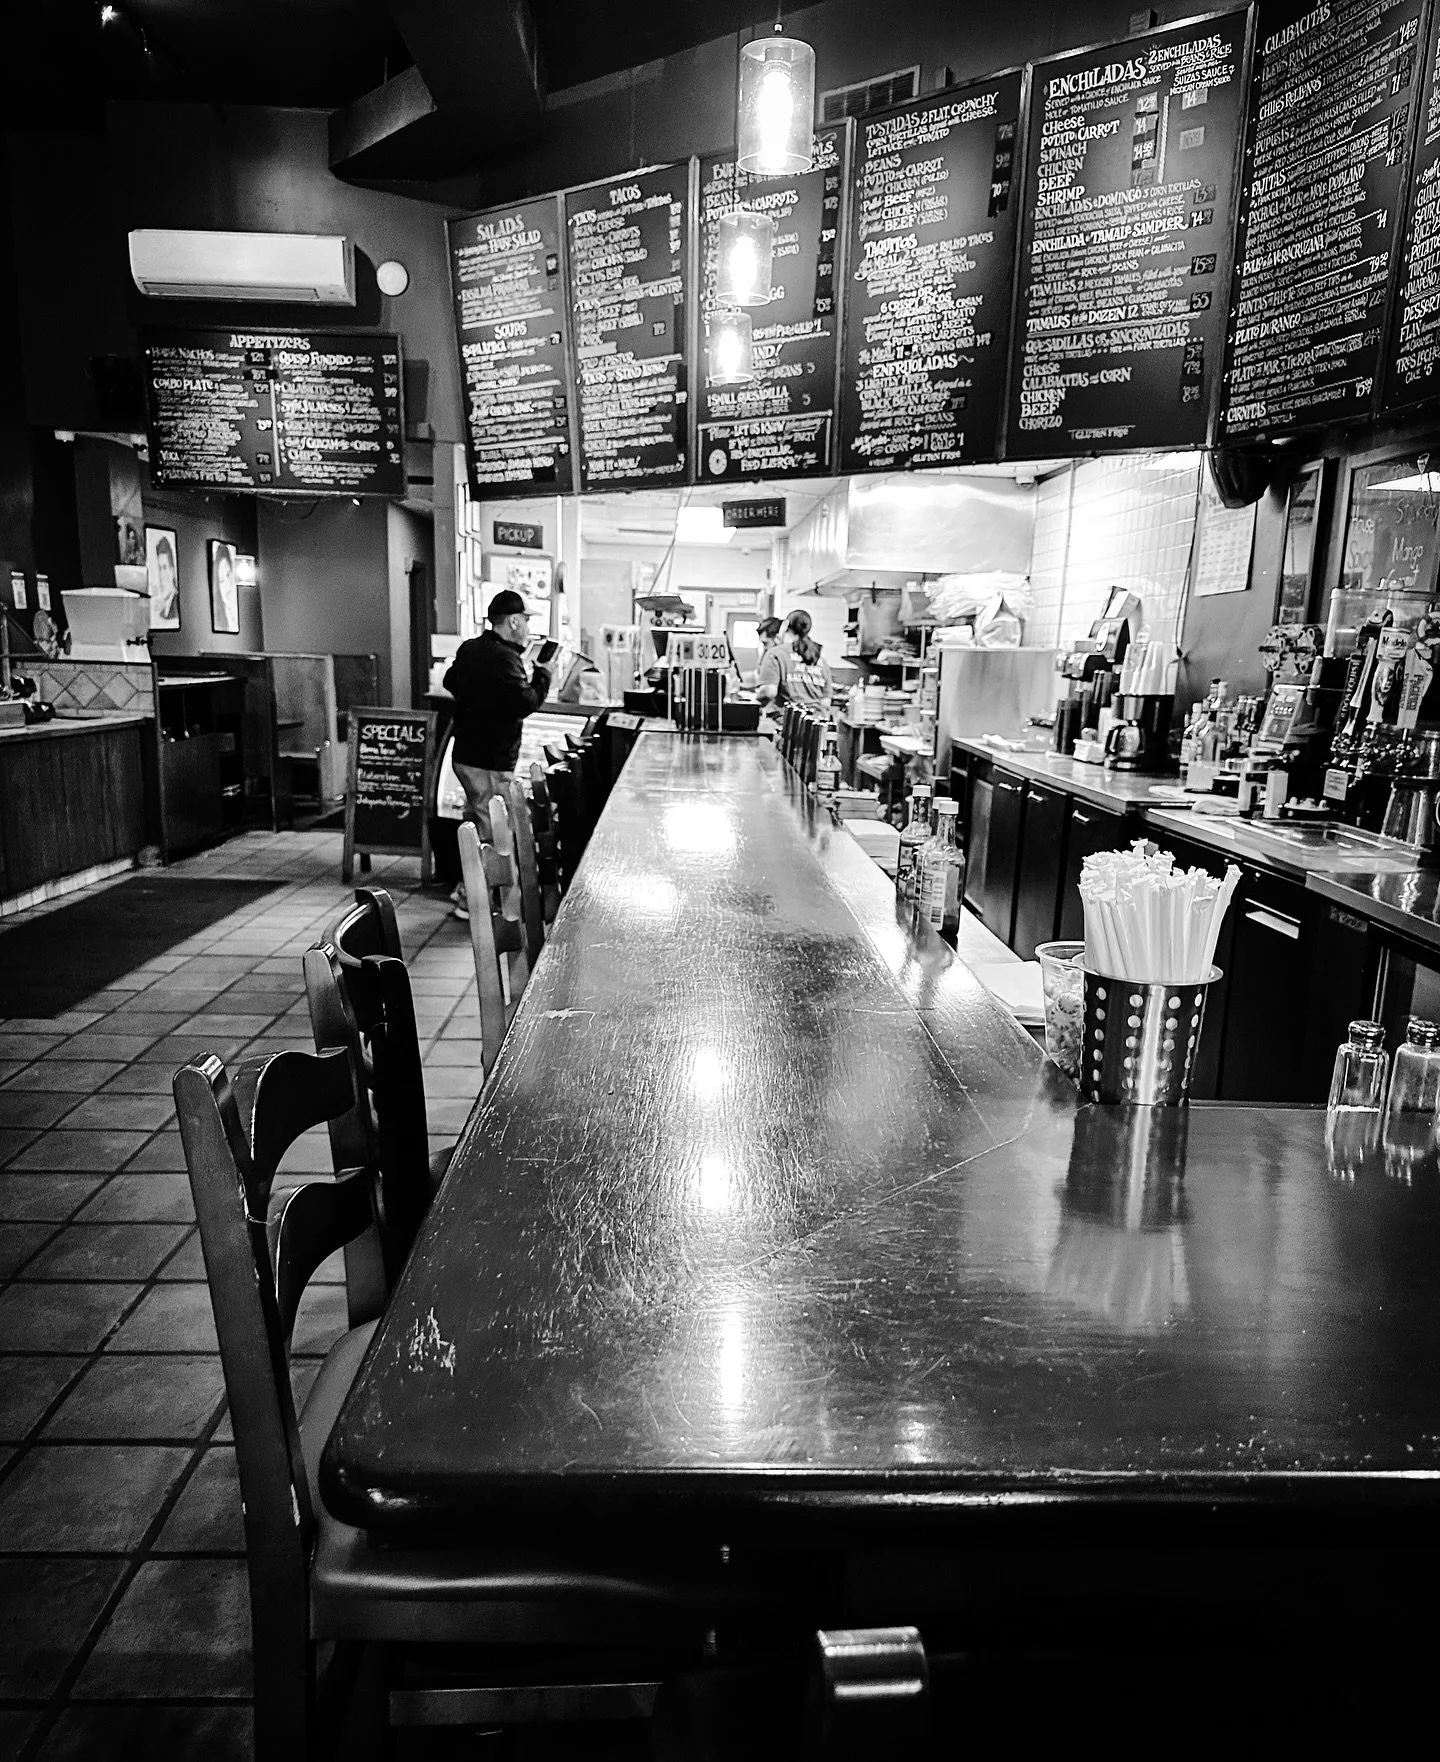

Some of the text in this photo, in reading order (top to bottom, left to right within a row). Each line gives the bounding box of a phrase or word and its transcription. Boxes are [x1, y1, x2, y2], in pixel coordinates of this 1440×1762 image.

[1264, 2, 1330, 54] CALABACITAS
[1156, 33, 1222, 65] ENCHILADAS
[1210, 43, 1232, 61] RICE
[1049, 57, 1147, 98] ENCHILADAS
[1142, 74, 1162, 91] SAUCE
[1201, 65, 1228, 80] SAUCE
[1104, 91, 1130, 109] SAUCE
[866, 111, 921, 141] TOSTADAS
[950, 91, 1000, 117] CRUNCHY
[917, 127, 950, 146] TOMATO
[1041, 120, 1121, 150] POTATO CARROT
[1040, 141, 1088, 163] SPINACH
[863, 156, 945, 188] POTATO CARROT
[864, 153, 902, 175] BEANS
[1038, 172, 1075, 193] BEEF
[1251, 168, 1286, 198] FAJITAS
[1328, 163, 1365, 193] POBLANO
[609, 184, 642, 206] TACOS
[1037, 185, 1086, 207] SHRIMP
[1034, 196, 1093, 221] ENCHILADAS
[476, 213, 525, 241] SALADS
[884, 214, 917, 233] BEEF
[864, 233, 918, 259] TAQUITOS
[1031, 233, 1086, 255] ENCHILADA
[1110, 259, 1139, 275] BEANS
[880, 302, 888, 314] 6
[1087, 304, 1127, 325] DOZEN
[494, 320, 528, 340] SOUPS
[1110, 321, 1190, 346] SINCRONIZADAS
[1259, 313, 1301, 337] DURANGO
[1400, 319, 1422, 343] FLAN
[229, 334, 311, 351] APPETIZERS
[152, 377, 183, 391] COMBO
[855, 379, 863, 392] 3
[882, 380, 934, 398] TORTILLAS
[1022, 366, 1132, 392] CALABACITAS CORN
[1021, 401, 1060, 418] BEEF
[1227, 401, 1266, 422] CARNITAS
[1019, 415, 1063, 431] CHORIZO
[1392, 537, 1424, 570] Mango
[711, 643, 726, 660] 20
[361, 724, 425, 743] SPECIALS
